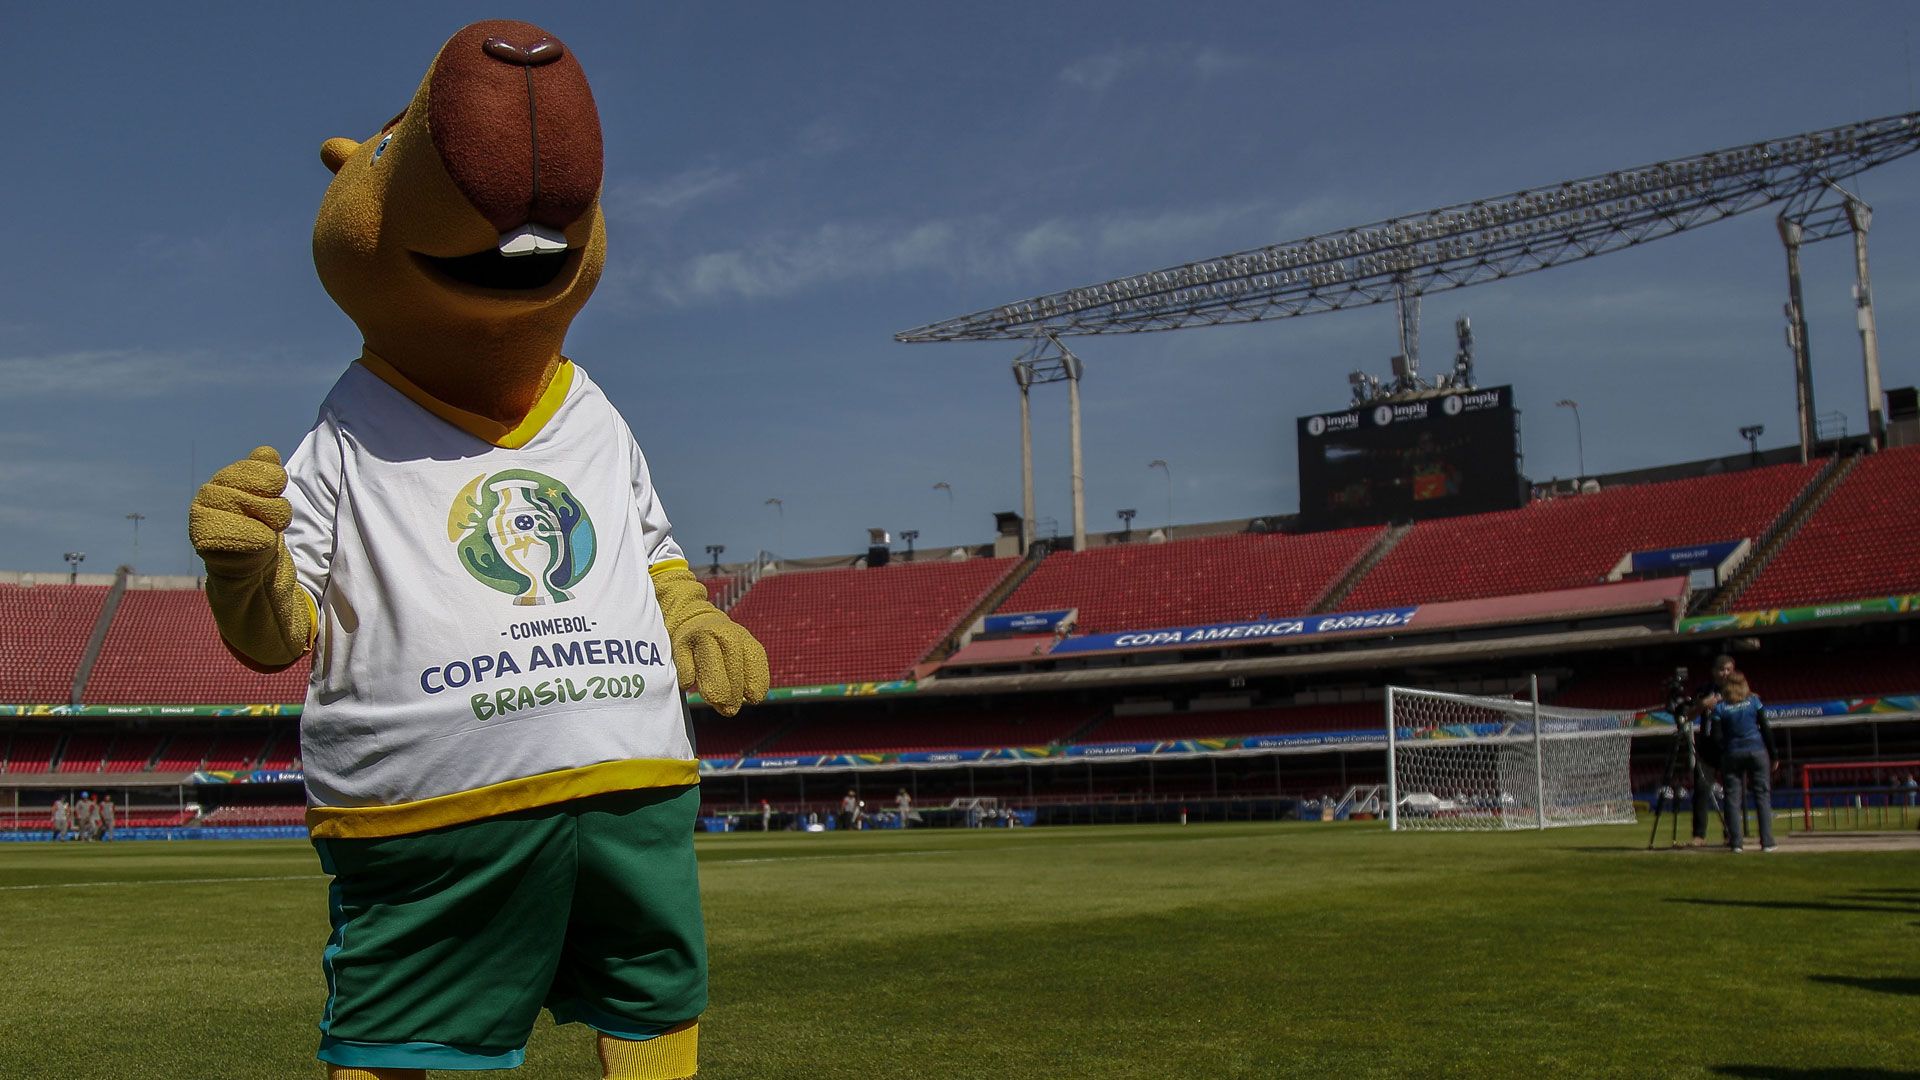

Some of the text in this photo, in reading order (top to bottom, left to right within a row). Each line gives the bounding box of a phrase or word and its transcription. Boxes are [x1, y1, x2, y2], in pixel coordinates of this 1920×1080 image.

[1464, 393, 1498, 404] imply
[1394, 402, 1427, 416] imply
[1327, 413, 1358, 426] imply
[1115, 630, 1182, 647] COPA
[1185, 620, 1304, 642] AMERICA
[1317, 612, 1402, 632] BRASIL
[420, 639, 665, 694] COPA AMERICA
[586, 674, 645, 699] 2019
[1780, 707, 1823, 717] AMERICA
